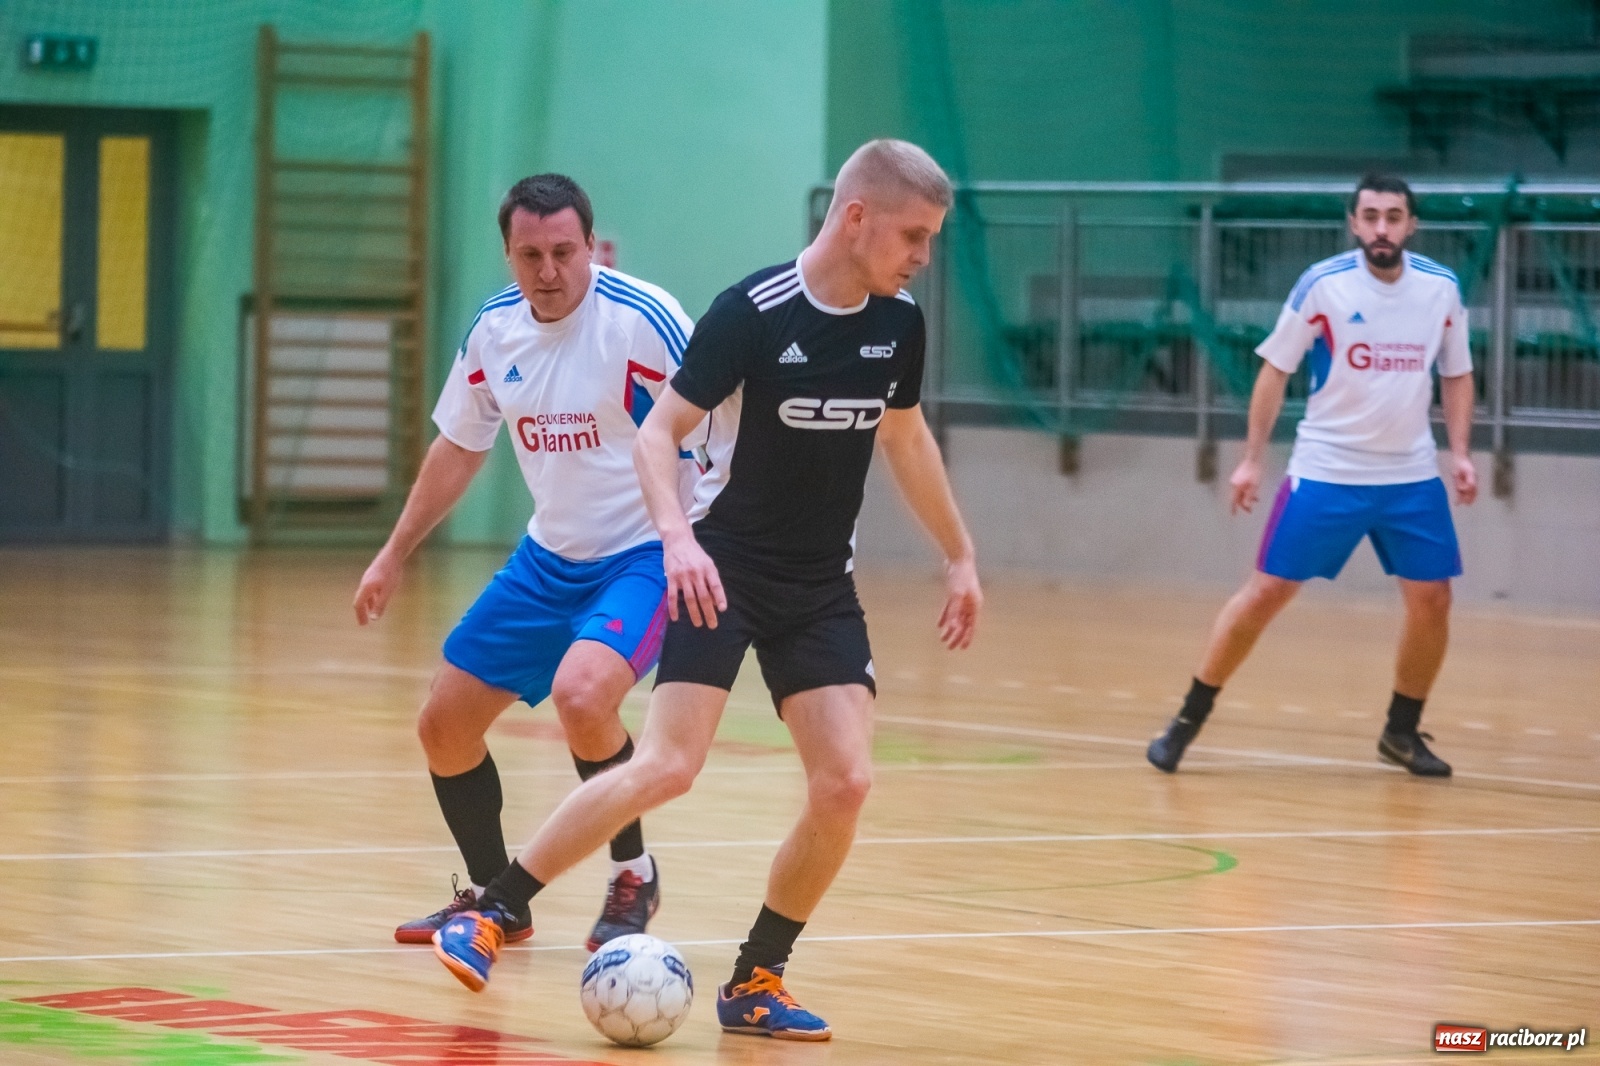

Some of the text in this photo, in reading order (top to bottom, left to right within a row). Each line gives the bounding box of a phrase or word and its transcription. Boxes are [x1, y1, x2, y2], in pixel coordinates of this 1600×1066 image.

[778, 355, 808, 364] adidas
[859, 345, 894, 359] ESD
[1347, 343, 1425, 372] Gianni
[536, 412, 597, 425] CUKIERNIA
[778, 397, 887, 430] ESD
[516, 416, 601, 453] Gianni
